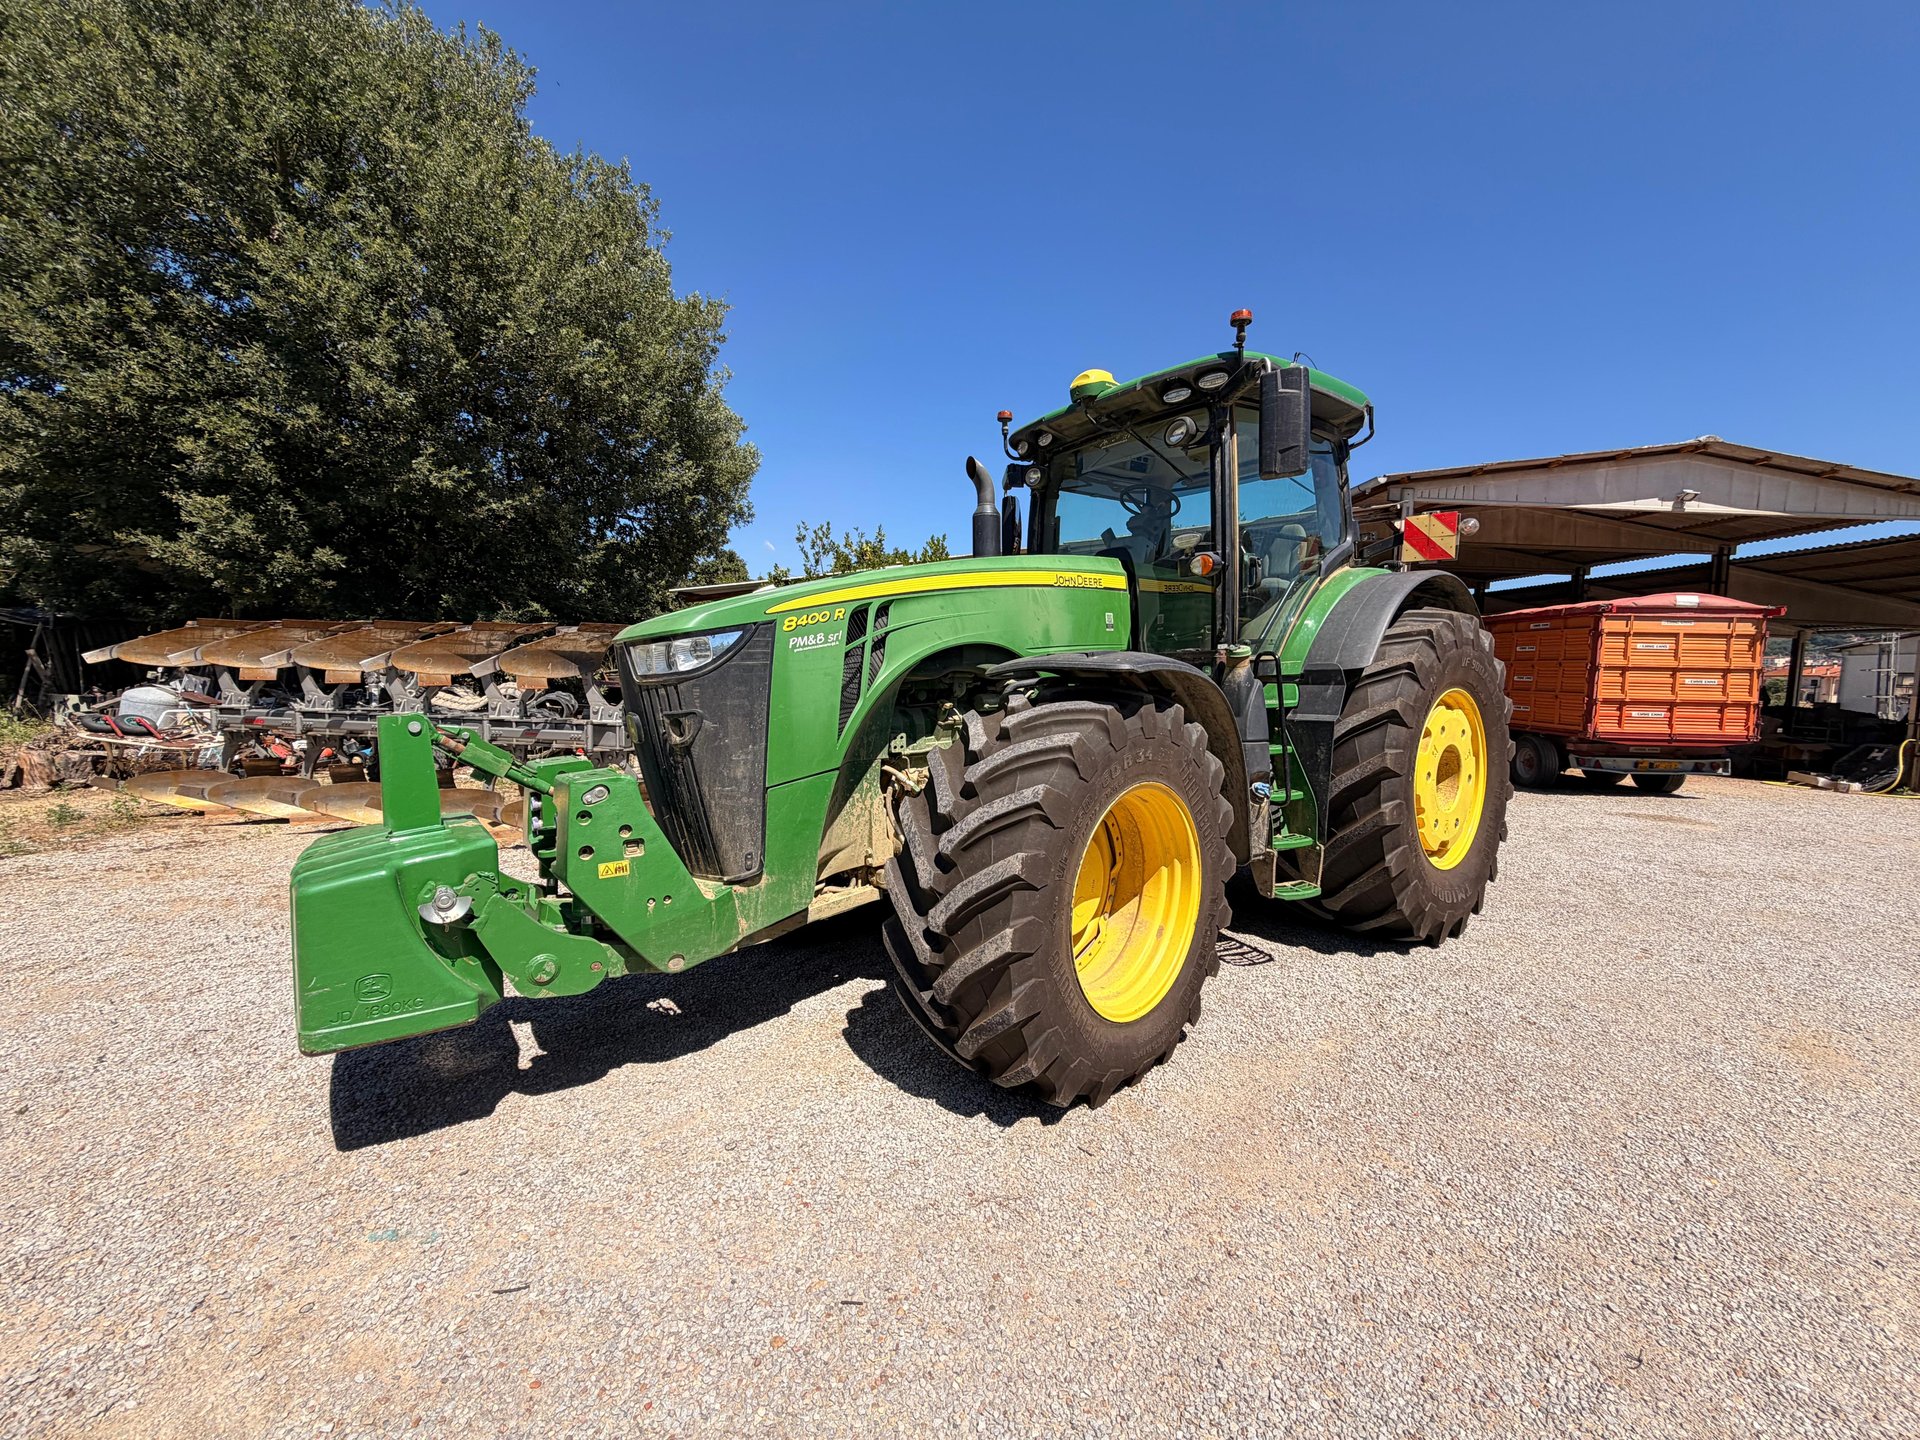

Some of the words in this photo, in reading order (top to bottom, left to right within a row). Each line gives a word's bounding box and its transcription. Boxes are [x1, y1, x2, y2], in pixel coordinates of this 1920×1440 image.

[782, 611, 831, 632] 8400
[834, 607, 846, 621] R
[789, 632, 825, 649] PM&B
[827, 630, 843, 643] srl
